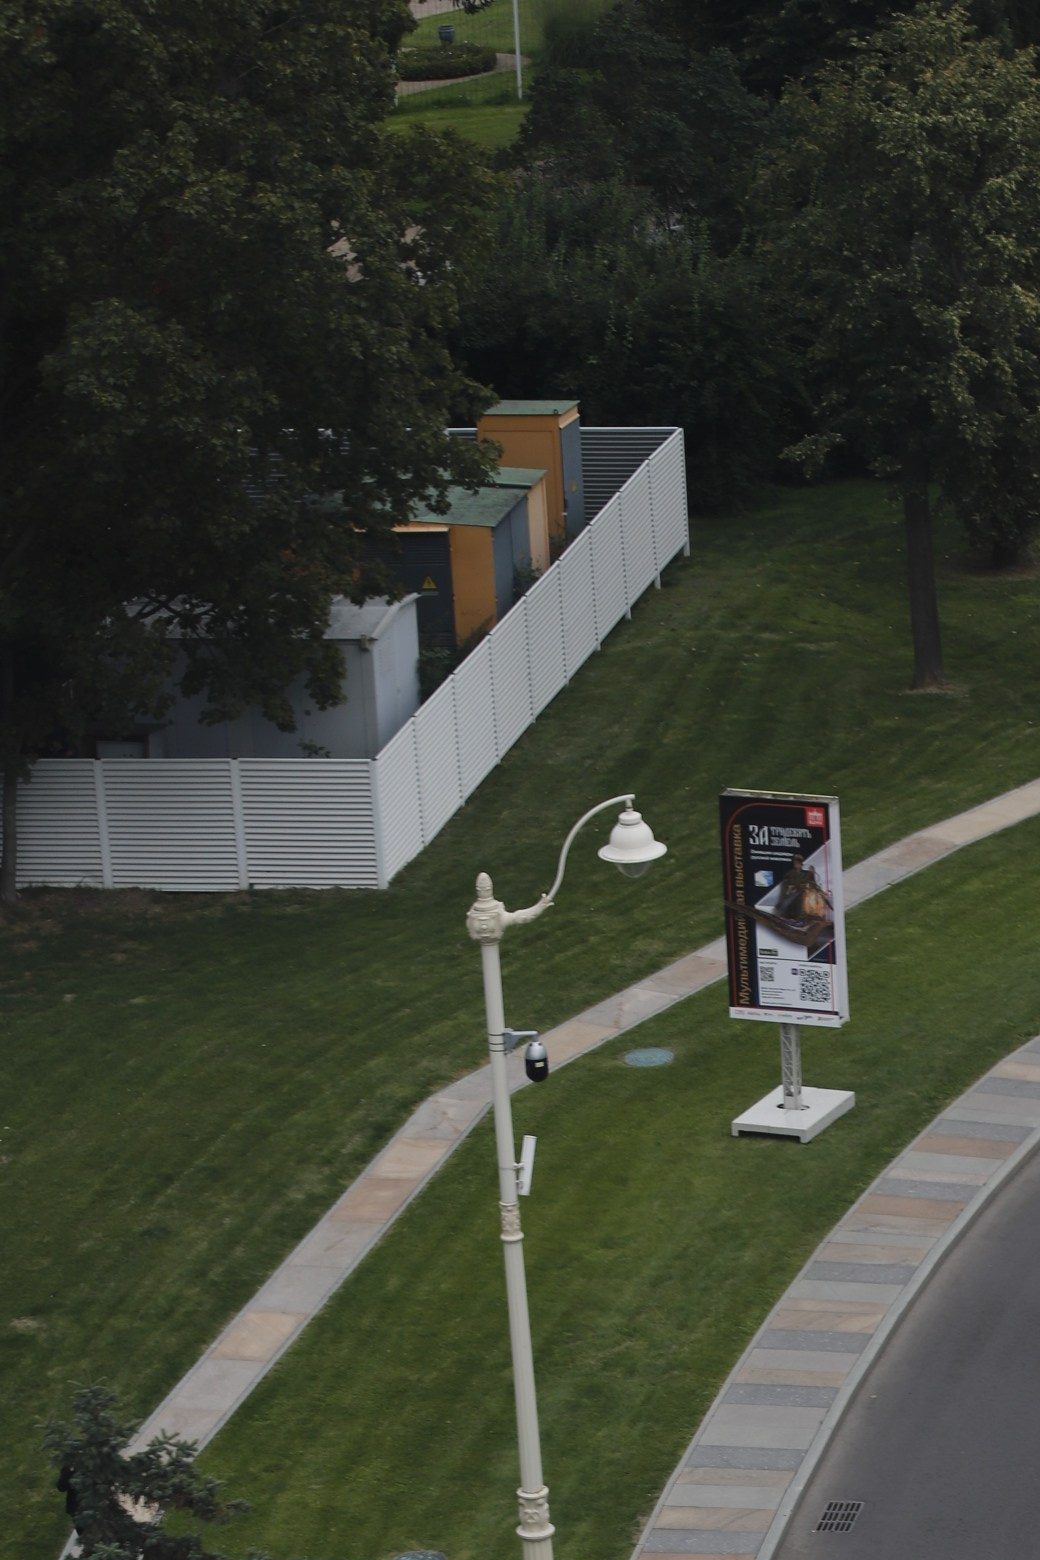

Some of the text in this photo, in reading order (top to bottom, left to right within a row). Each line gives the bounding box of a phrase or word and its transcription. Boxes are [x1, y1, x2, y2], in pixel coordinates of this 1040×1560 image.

[748, 825, 769, 846] ЗА
[732, 824, 750, 1004] Мультимедийая выставка
